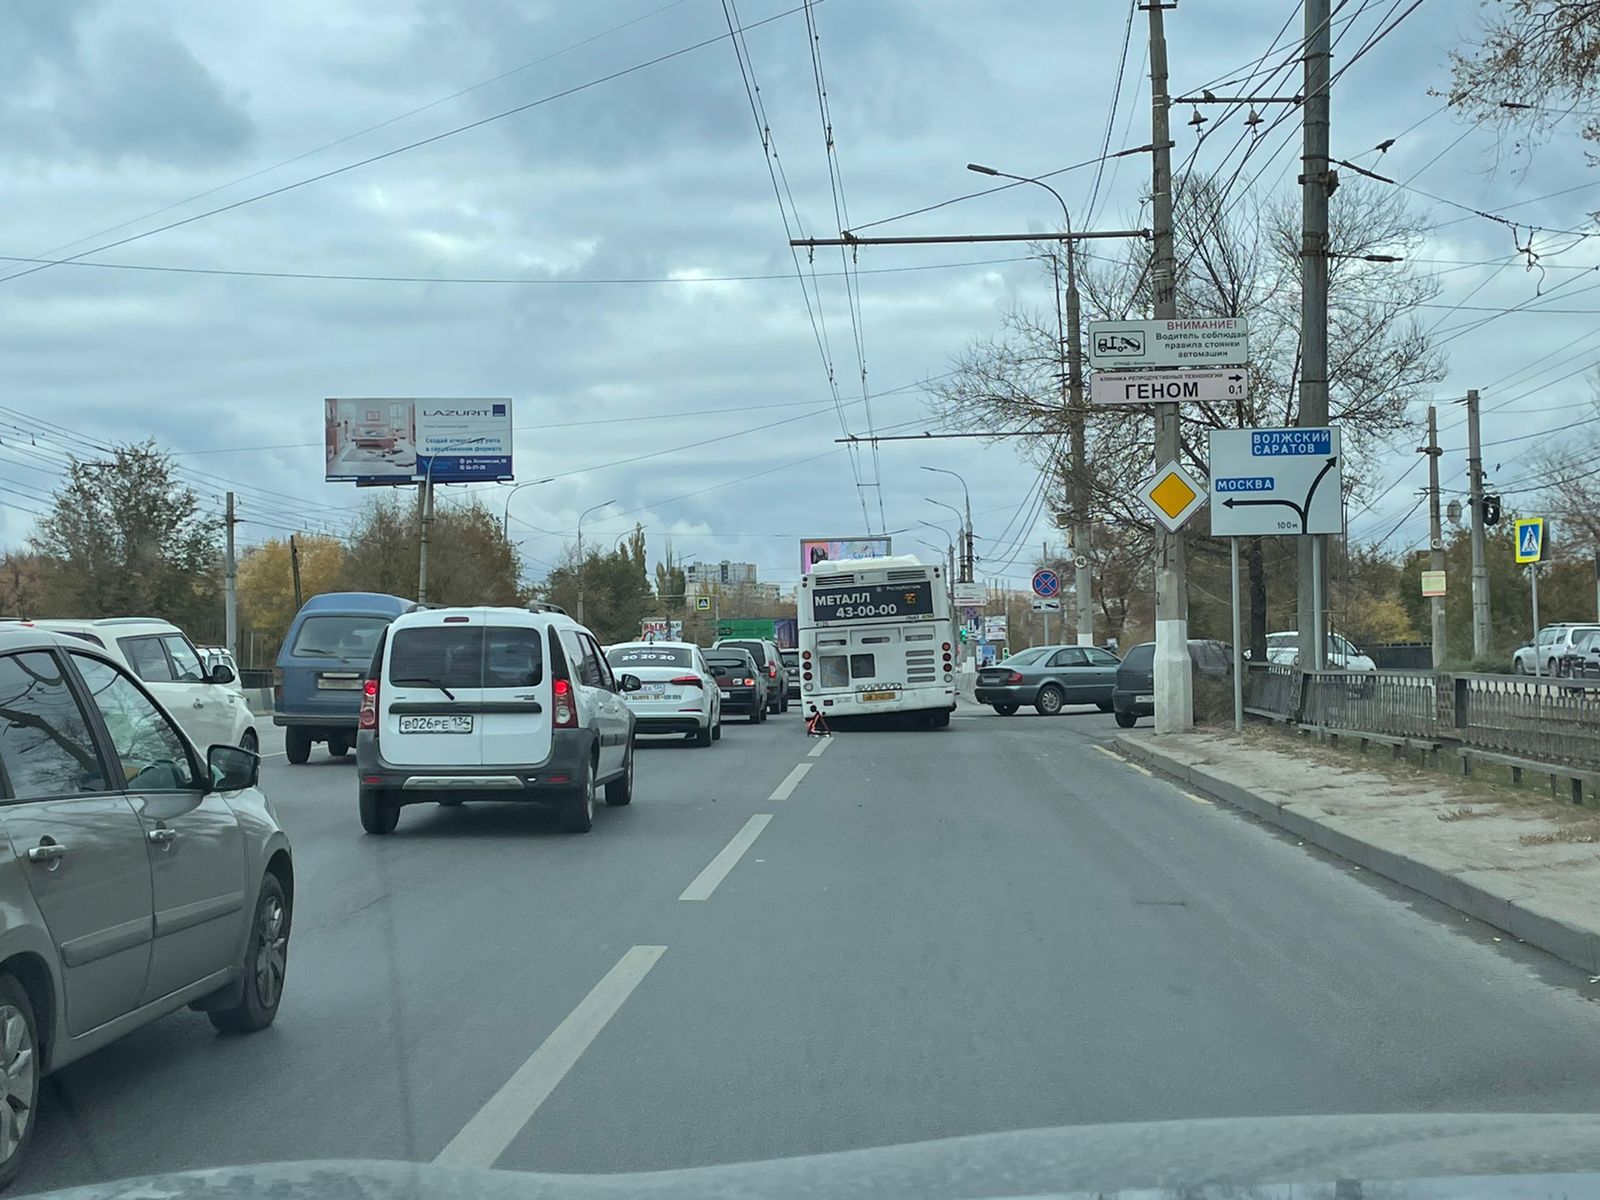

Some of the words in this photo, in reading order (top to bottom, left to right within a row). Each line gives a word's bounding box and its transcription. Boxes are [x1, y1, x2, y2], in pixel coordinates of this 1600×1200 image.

[1167, 320, 1238, 331] ВНИМАНИЕ!
[1156, 332, 1199, 341] Водитель
[1201, 330, 1248, 340] соблюдай
[1165, 342, 1203, 350] правила
[1204, 341, 1240, 349] стоянки
[1178, 350, 1228, 358] автомашин
[1125, 382, 1199, 400] ГЕНОМ
[1228, 384, 1243, 396] 0,1
[1253, 430, 1330, 444] ВОЛЖСКИЙ
[1253, 443, 1316, 456] САРАТОВ
[1217, 479, 1273, 491] МОСКВА
[814, 592, 871, 607] МЕТАЛЛ
[836, 603, 898, 618] 43-00-00
[403, 717, 449, 730] В026РЕ
[452, 716, 471, 727] 134
